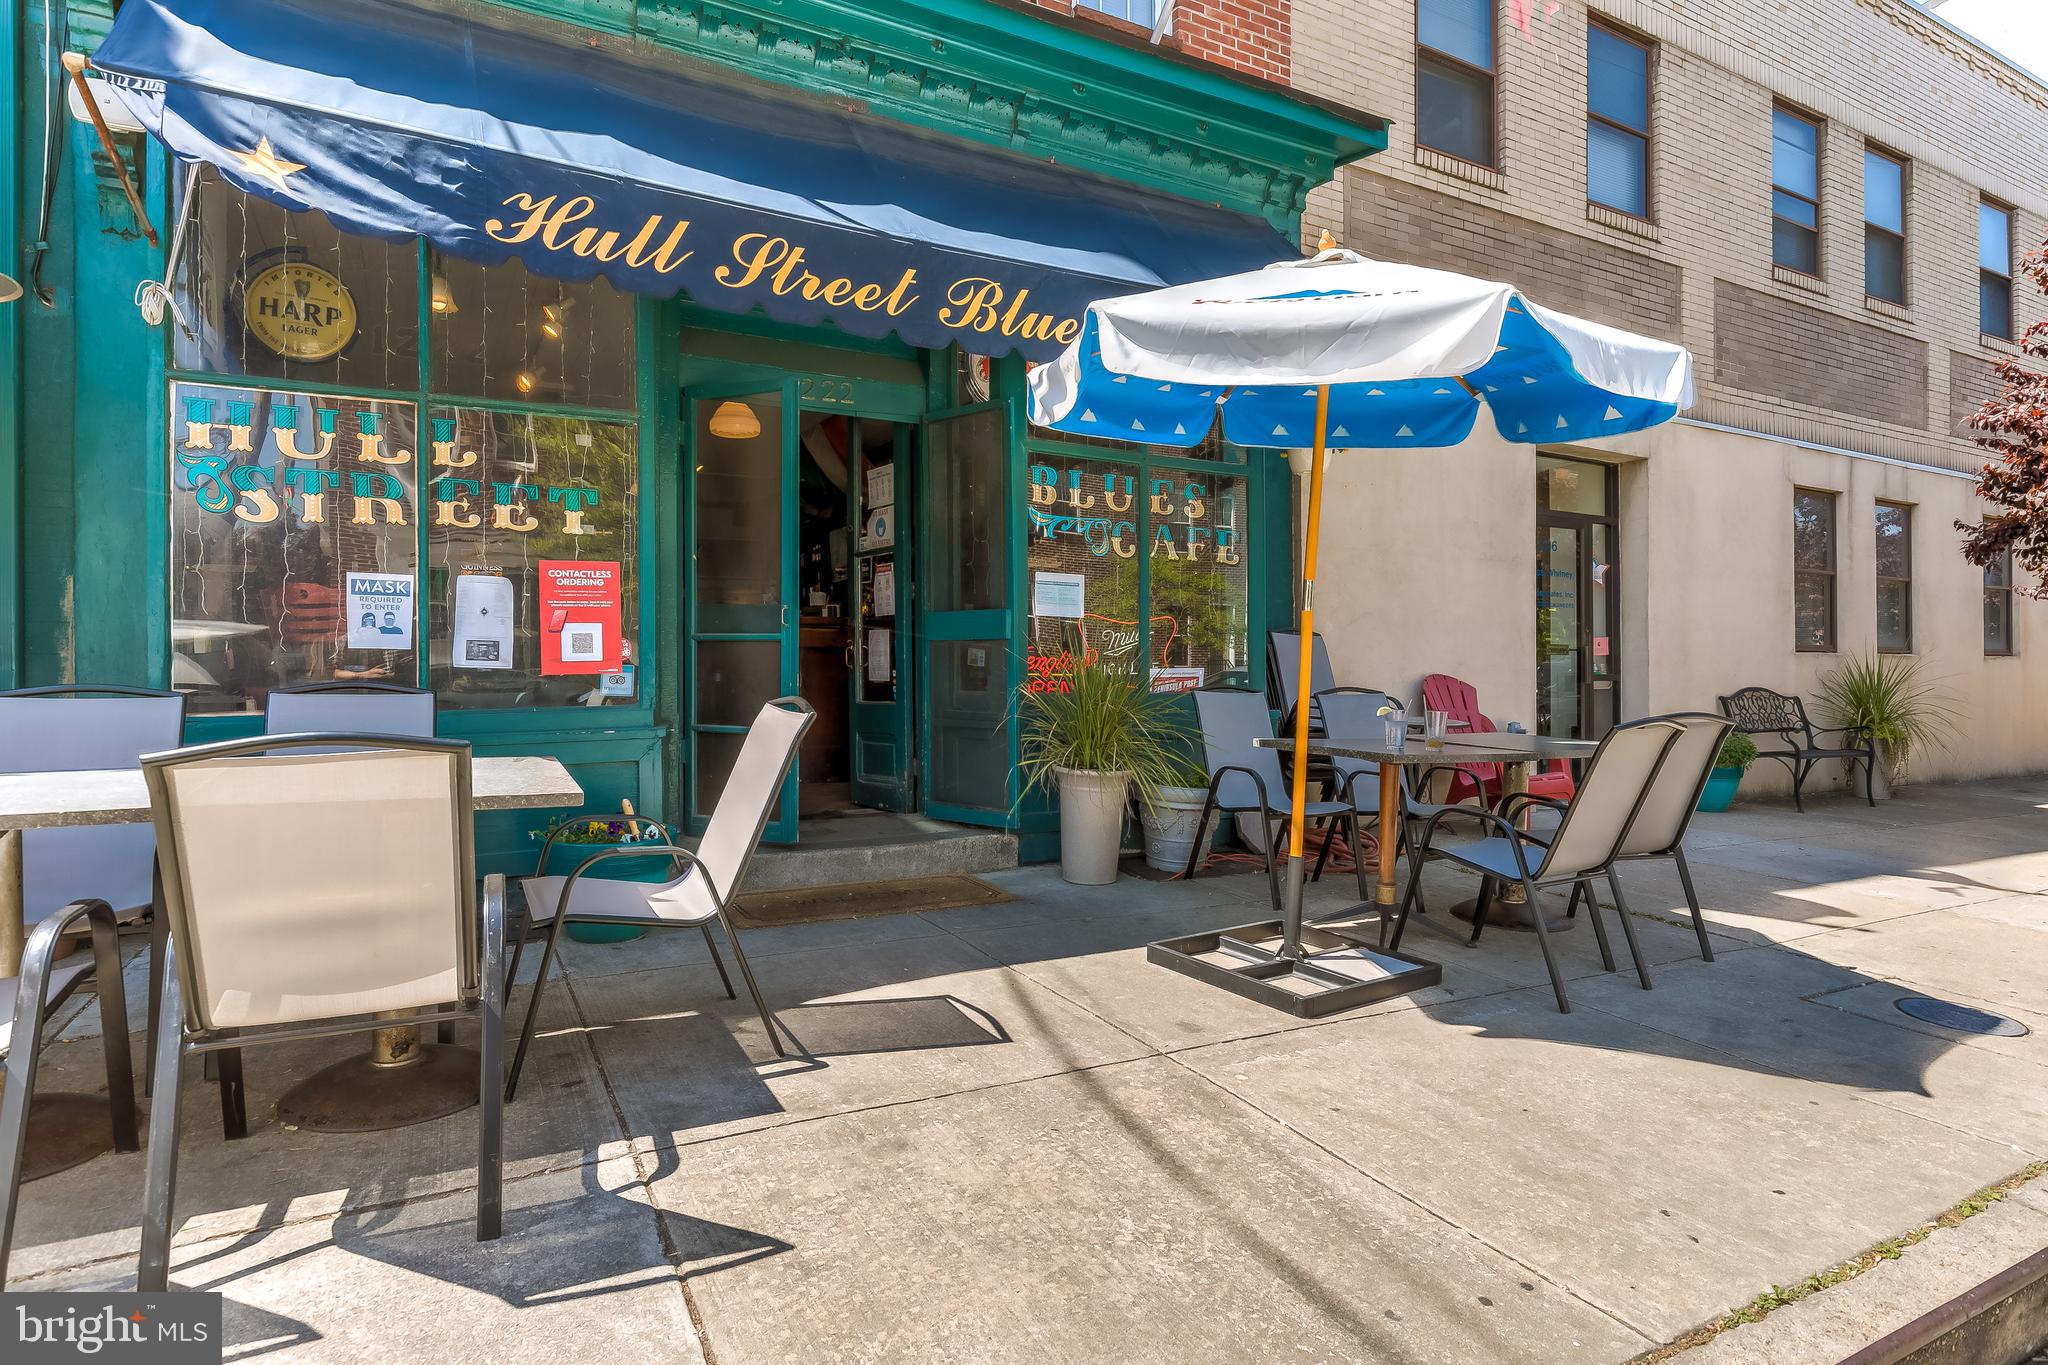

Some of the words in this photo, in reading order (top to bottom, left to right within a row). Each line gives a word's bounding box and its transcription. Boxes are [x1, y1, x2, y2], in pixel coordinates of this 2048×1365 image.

[264, 269, 341, 297] IMPORTED
[485, 192, 694, 273] Hull
[714, 232, 919, 316] Street
[938, 277, 1079, 345] Blue
[259, 297, 342, 328] HARP
[282, 324, 318, 337] LAGER
[182, 396, 477, 468] HULL
[231, 466, 599, 535] STREET
[1031, 465, 1206, 518] BLUES
[1111, 521, 1240, 565] CAFE
[355, 580, 407, 594] MASK
[548, 569, 612, 578] CONTACTLESS
[556, 578, 605, 586] ORDERING
[359, 596, 402, 604] REQUIRED
